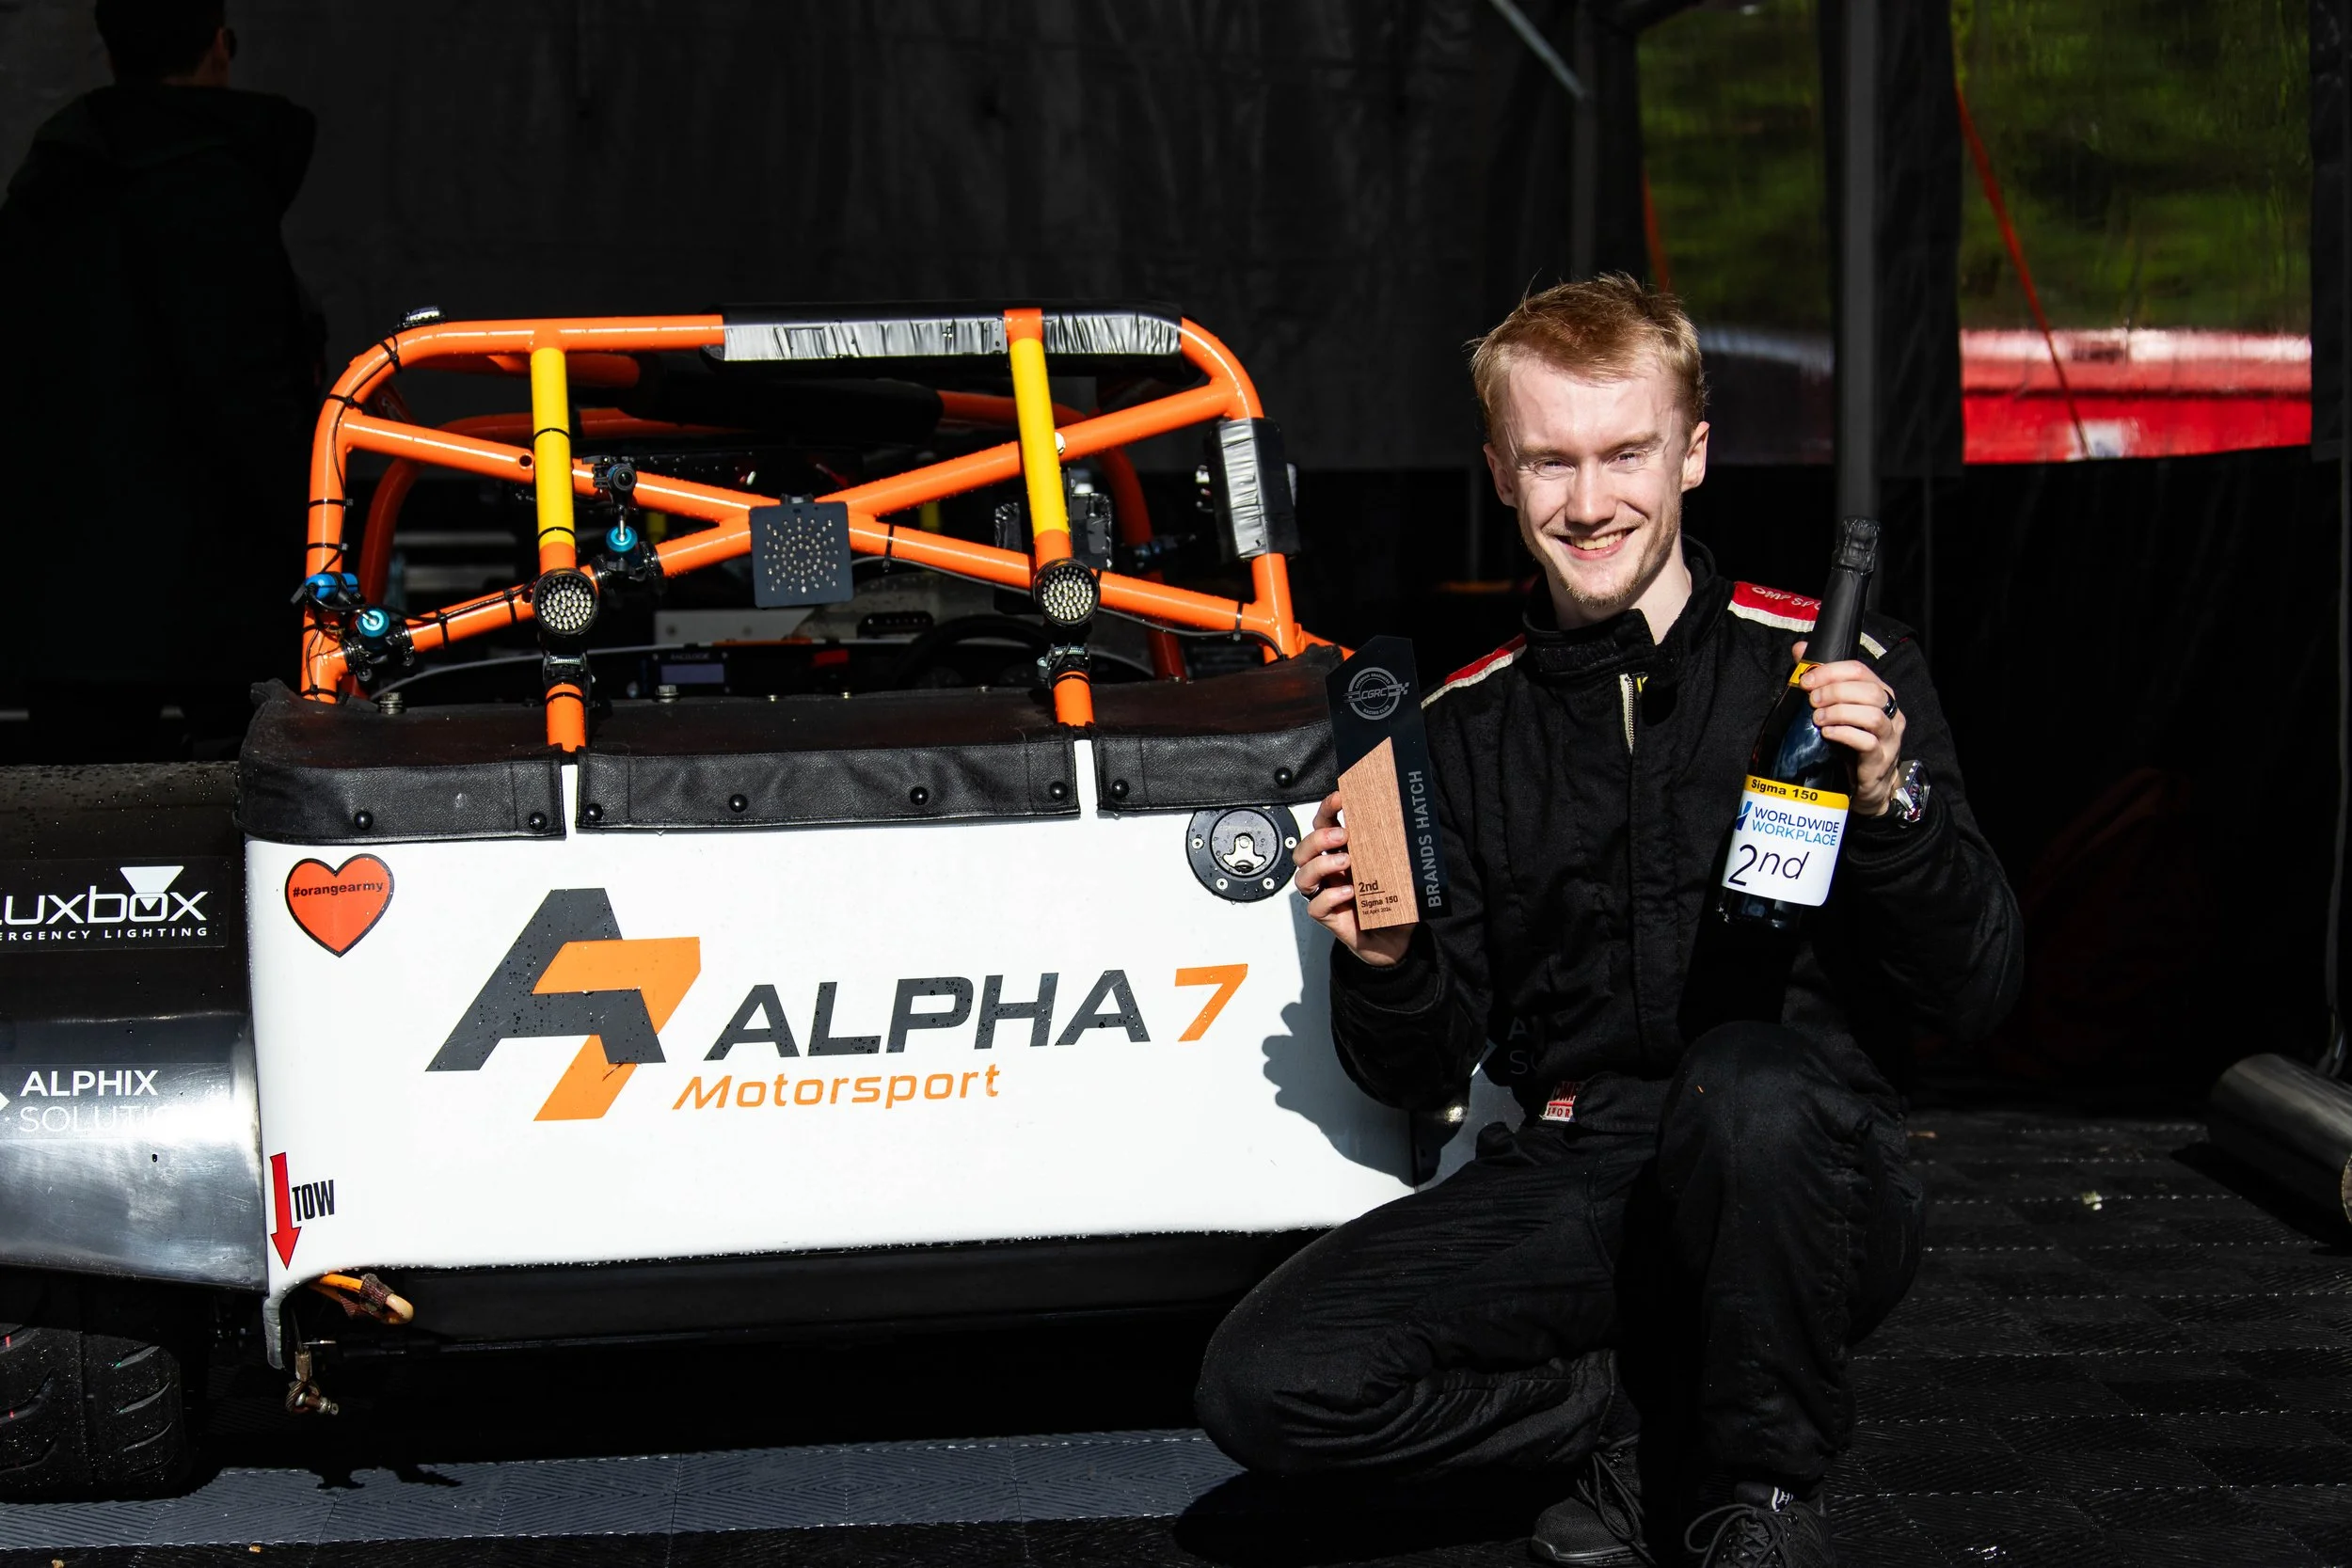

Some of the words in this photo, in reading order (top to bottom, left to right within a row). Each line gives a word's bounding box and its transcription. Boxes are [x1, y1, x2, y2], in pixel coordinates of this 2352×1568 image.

[1751, 586, 1791, 600] OMP
[1361, 688, 1388, 700] CGRC
[1408, 769, 1431, 830] HATCH
[1751, 779, 1787, 796] Sigma
[1792, 788, 1819, 801] 150
[1752, 819, 1837, 847] WORKPLACE
[1755, 806, 1840, 833] WORLDWIDE
[1419, 833, 1442, 908] BRANDS
[1727, 844, 1810, 886] 2nd
[293, 880, 384, 897] #orangearmy
[1359, 880, 1379, 893] 2nd
[0, 885, 208, 926] uxbox
[1360, 898, 1384, 909] Sigma
[1385, 895, 1399, 904] 150
[103, 927, 207, 939] LIGHTING
[704, 969, 1152, 1061] ALPHA
[1175, 962, 1249, 1042] 7
[20, 1069, 159, 1097] ALPHIX
[672, 1063, 1001, 1111] Motorsport
[292, 1179, 335, 1222] TOW
